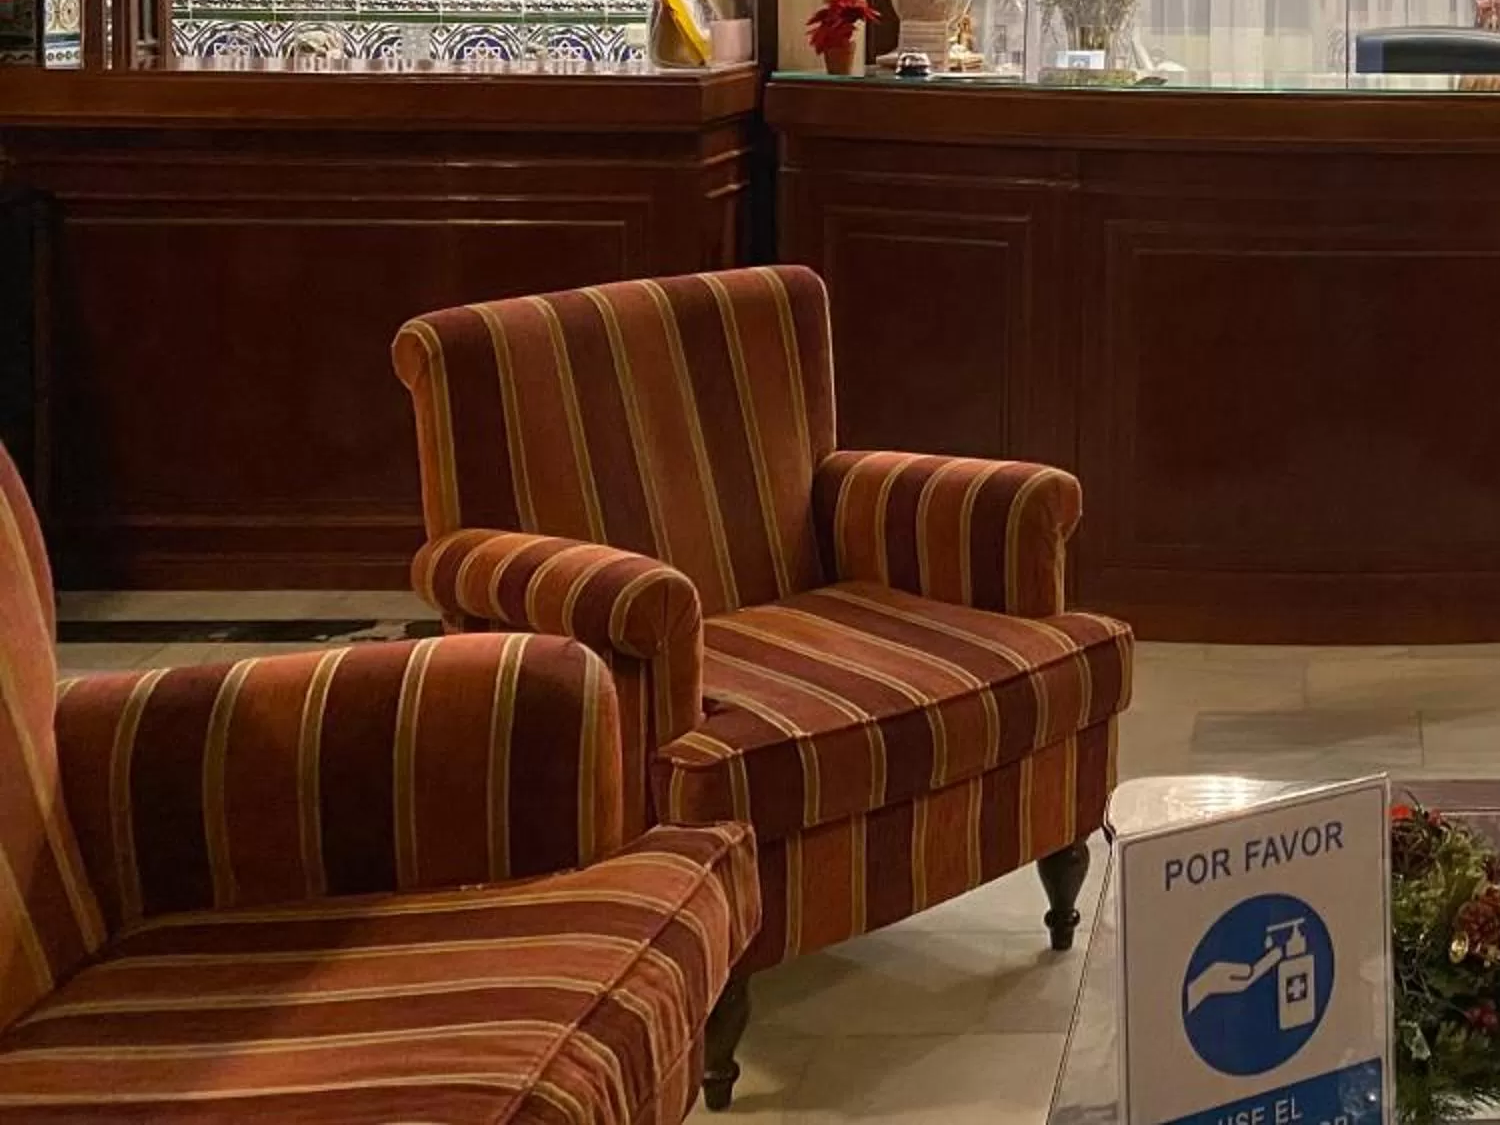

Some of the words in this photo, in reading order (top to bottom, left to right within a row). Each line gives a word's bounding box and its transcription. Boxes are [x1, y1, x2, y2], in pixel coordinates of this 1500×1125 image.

[1164, 848, 1232, 891] POR
[1244, 820, 1344, 872] FAVOR
[1218, 1106, 1266, 1125] SE
[1274, 1095, 1303, 1125] EL
